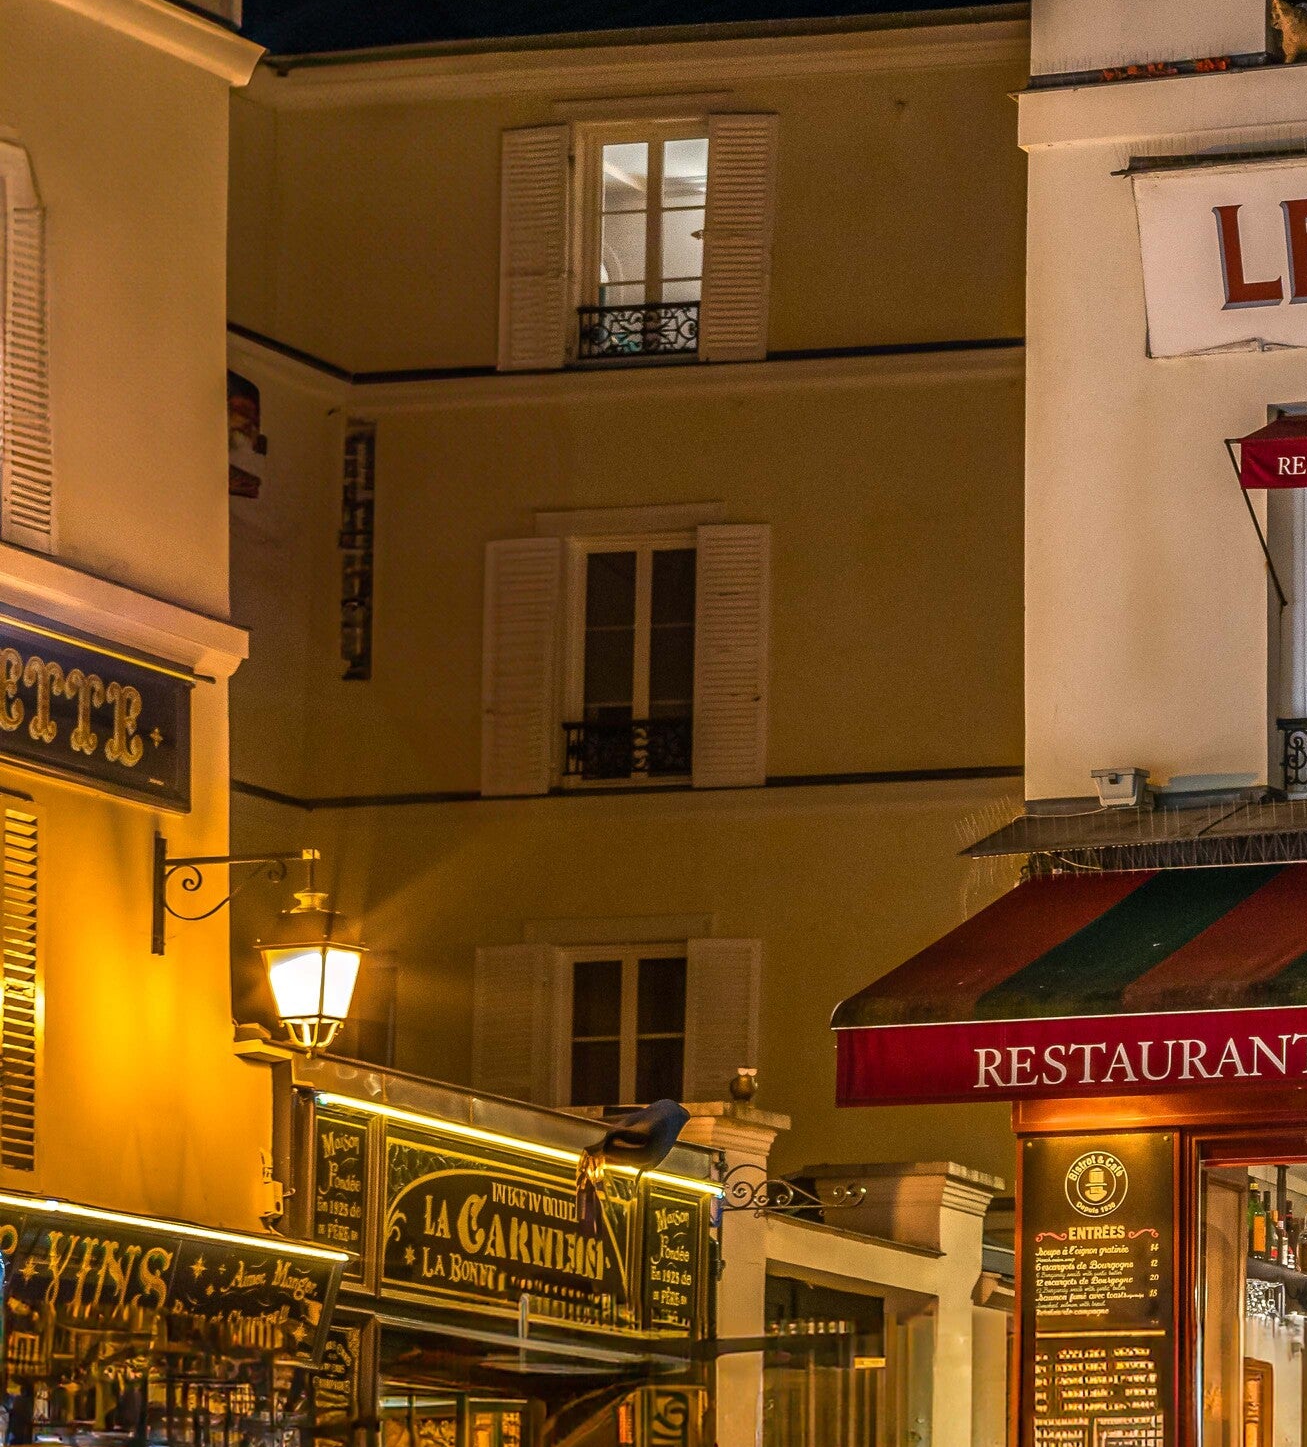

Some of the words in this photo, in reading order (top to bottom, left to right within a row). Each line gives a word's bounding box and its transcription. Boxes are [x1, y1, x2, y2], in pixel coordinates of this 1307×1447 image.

[1068, 1154, 1097, 1181] Bistrot
[1068, 1225, 1126, 1240] ENTRÉES
[45, 1229, 173, 1317] VINS
[1076, 1261, 1088, 1270] de
[1079, 1277, 1089, 1285] de
